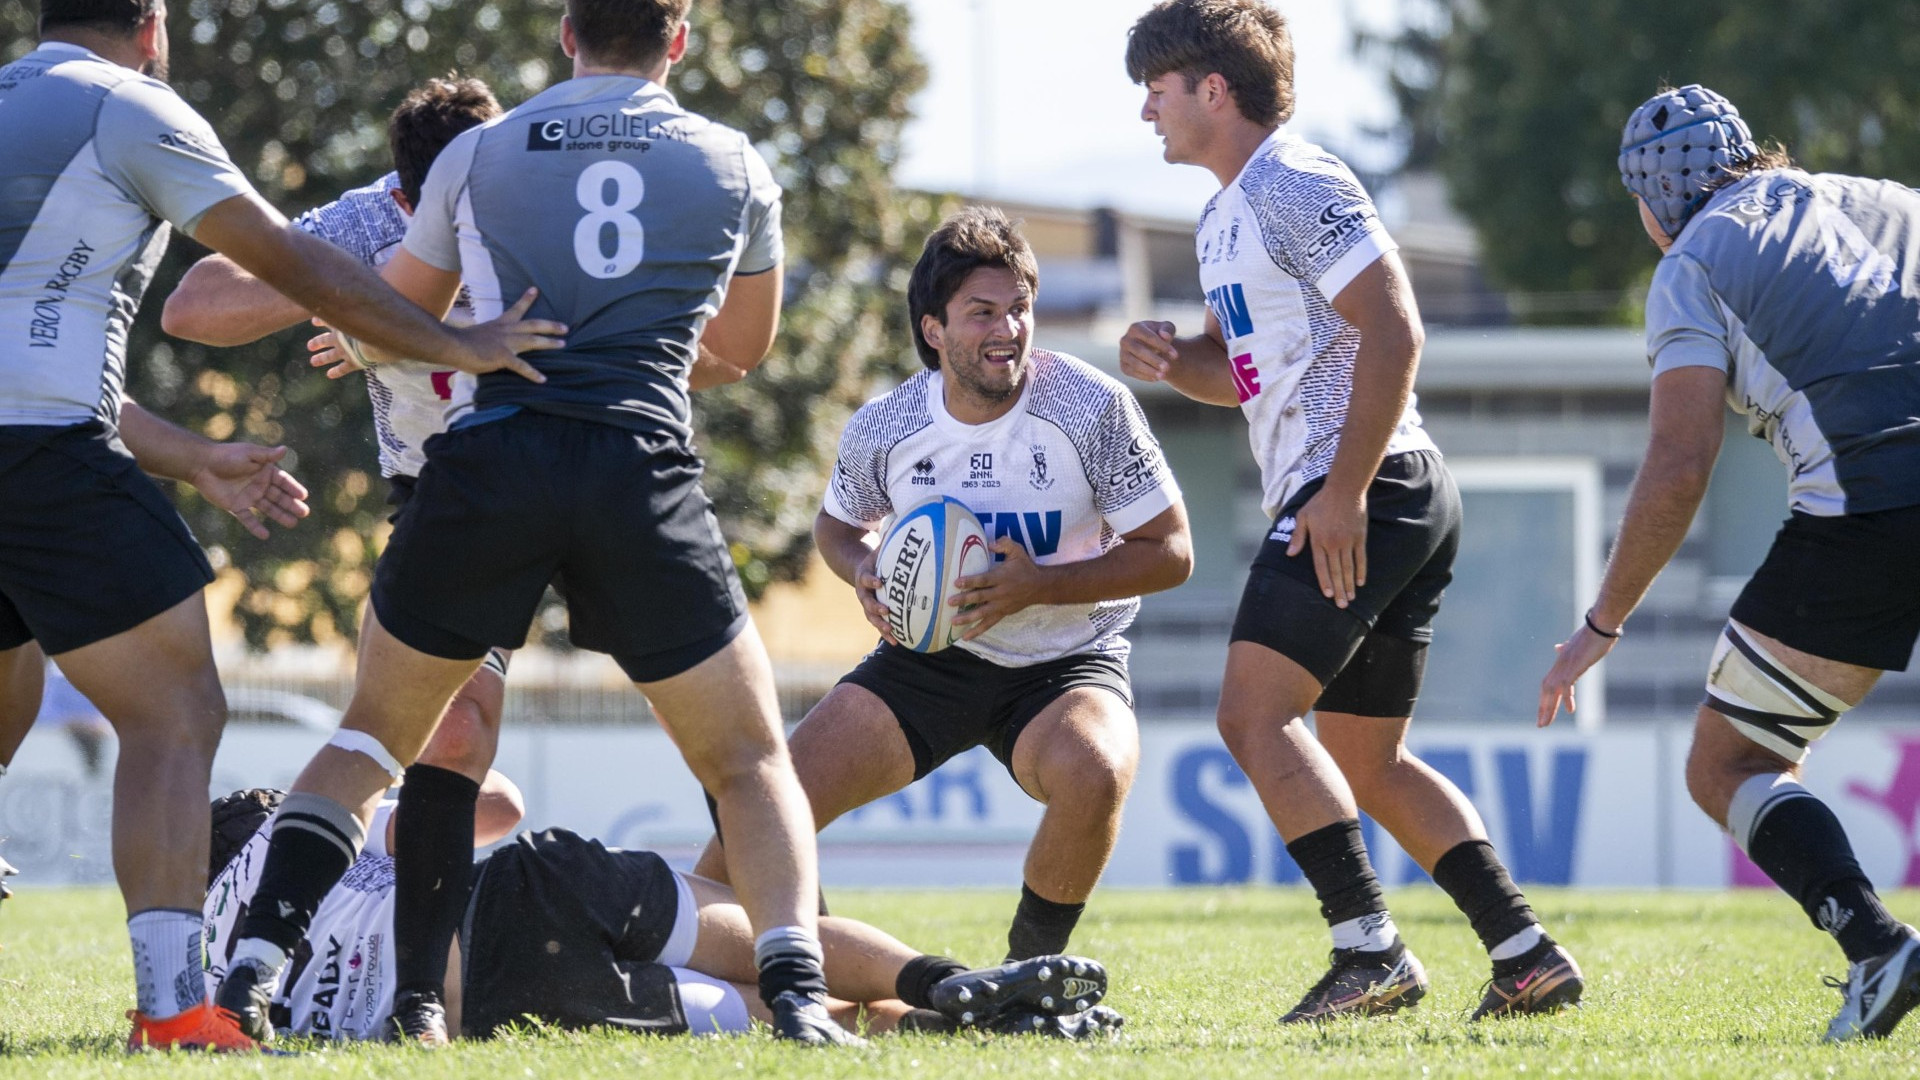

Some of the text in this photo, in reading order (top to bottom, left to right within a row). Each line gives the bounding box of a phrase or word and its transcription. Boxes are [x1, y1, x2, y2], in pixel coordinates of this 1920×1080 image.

[566, 139, 650, 154] stone group
[573, 160, 645, 279] 8
[970, 453, 993, 470] 60
[888, 527, 924, 642] GILBERT
